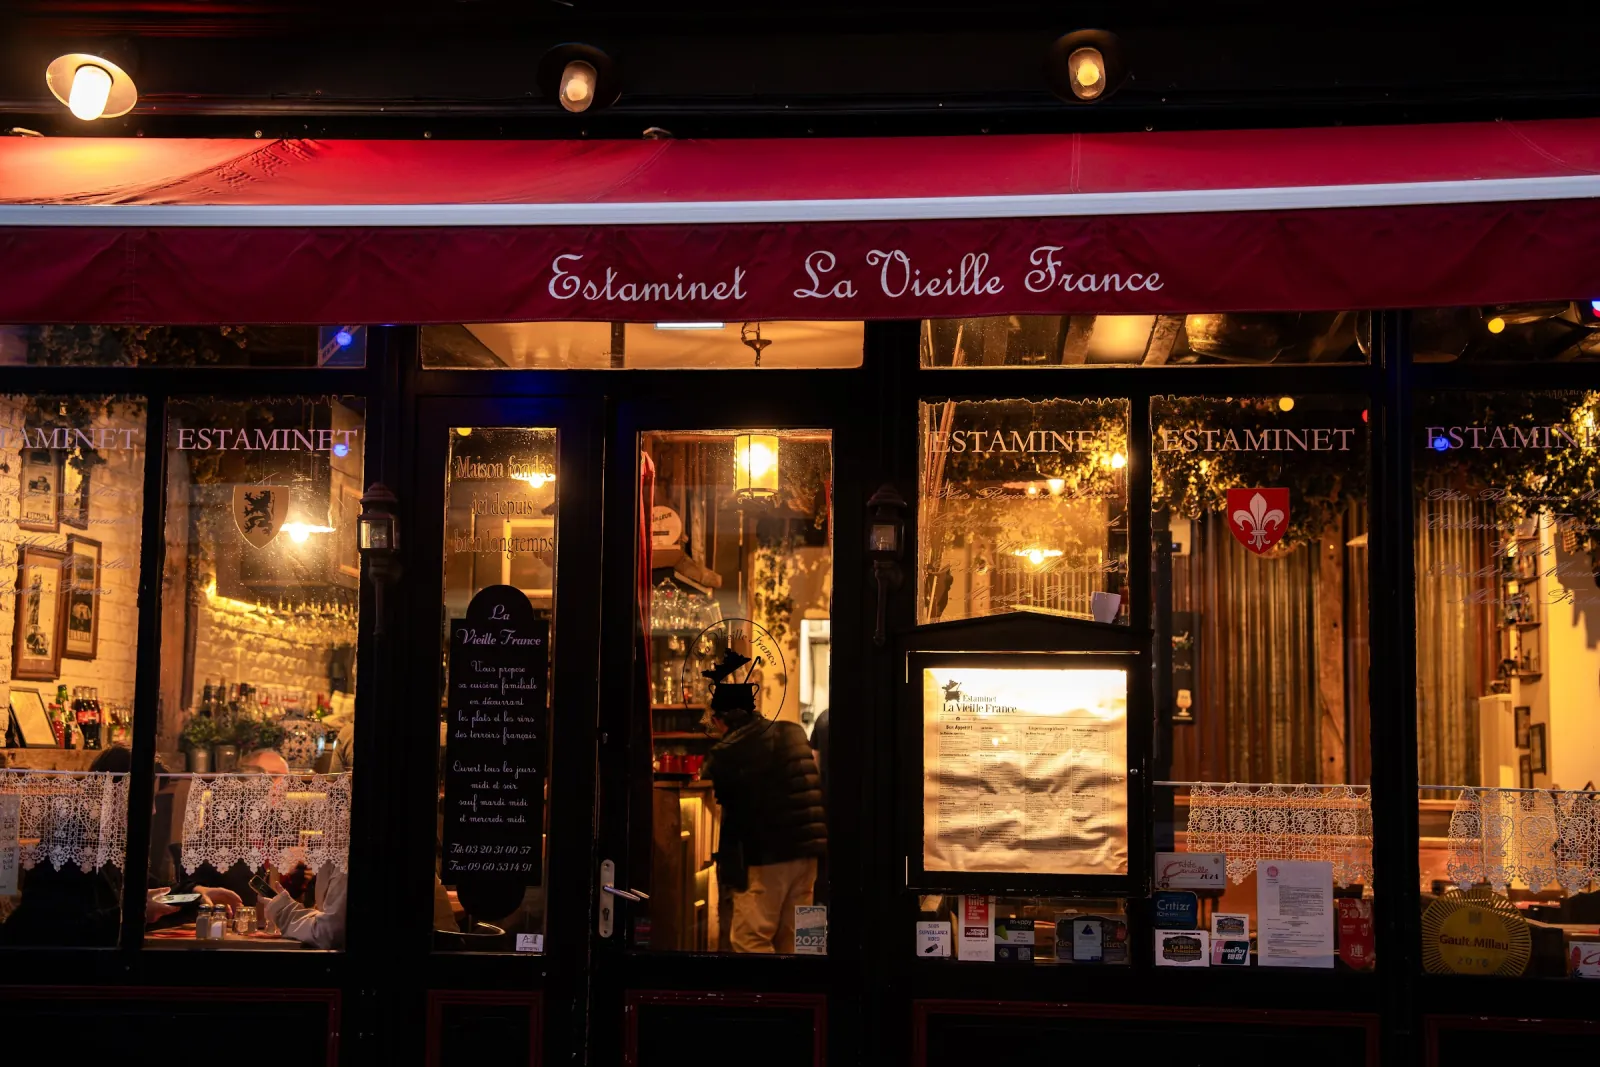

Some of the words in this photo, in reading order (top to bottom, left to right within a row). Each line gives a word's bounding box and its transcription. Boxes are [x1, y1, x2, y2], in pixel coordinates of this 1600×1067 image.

[548, 253, 747, 301] Estaminet
[793, 250, 858, 299] La
[866, 249, 1004, 298] Vieille
[1024, 245, 1164, 293] France
[176, 427, 358, 451] ESTAMINET
[930, 429, 1117, 453] ESTAMINET
[1160, 428, 1355, 452] ESTAMINET
[456, 455, 504, 479] Maison
[471, 492, 488, 515] ici
[490, 492, 534, 523] depuis
[454, 529, 482, 553] bien
[485, 530, 554, 560] longtemps
[488, 604, 510, 620] La
[457, 628, 497, 645] Vieille
[500, 628, 541, 646] France
[749, 629, 777, 667] France
[471, 660, 496, 673] Vous
[498, 667, 526, 679] propose
[501, 677, 537, 696] familiale
[943, 702, 954, 712] La
[956, 702, 984, 713] Vieille
[985, 703, 1017, 714] France
[458, 710, 469, 722] les
[471, 710, 491, 728] plats
[493, 713, 501, 722] et
[503, 710, 514, 722] les
[517, 715, 535, 723] vins
[455, 729, 467, 738] des
[470, 729, 500, 739] terroirs
[502, 727, 537, 745] français
[453, 760, 481, 773] Ouvert
[484, 764, 501, 773] tous
[502, 760, 513, 773] les
[514, 765, 537, 779] jours
[470, 780, 490, 789] midi
[492, 781, 500, 789] et
[502, 782, 518, 790] soir
[458, 793, 478, 813] sauf
[480, 797, 506, 806] mardi
[508, 798, 529, 807] midi
[459, 814, 466, 823] et
[469, 814, 503, 823] mercredi
[506, 815, 527, 823] midi
[465, 845, 478, 854] 03
[480, 845, 492, 854] 20
[493, 845, 504, 854] 31
[505, 845, 518, 854] 00
[519, 846, 532, 855] 57
[467, 862, 481, 871] 09
[482, 862, 495, 871] 60
[509, 862, 520, 872] 14
[521, 863, 532, 872] 91
[1156, 899, 1191, 911] Critizr
[796, 936, 826, 946] 2022
